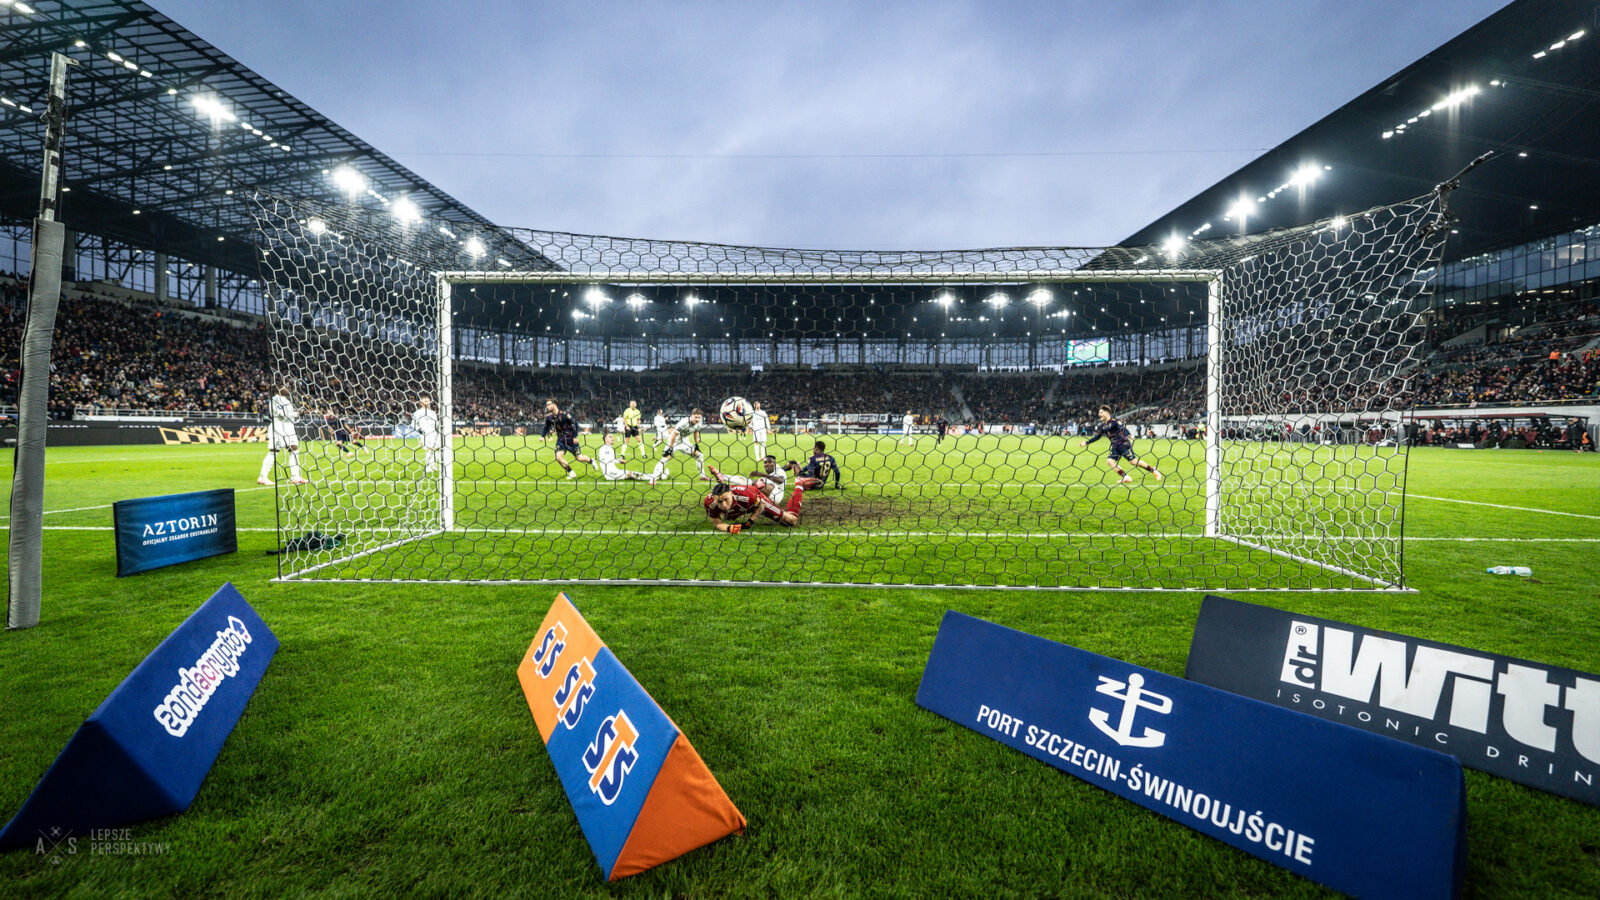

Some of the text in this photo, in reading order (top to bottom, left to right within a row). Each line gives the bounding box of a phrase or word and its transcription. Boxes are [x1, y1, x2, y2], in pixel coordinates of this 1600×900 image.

[142, 513, 218, 538] AZTORIN
[142, 537, 168, 546] OFICJALNY
[168, 532, 189, 542] ZEGAREK
[533, 620, 639, 805] STS STS STS
[1276, 688, 1449, 745] ISOTONIC
[1321, 626, 1600, 766] Witt
[976, 704, 1316, 867] PORT SZCZECIN-ŚWINOUJŚCIE
